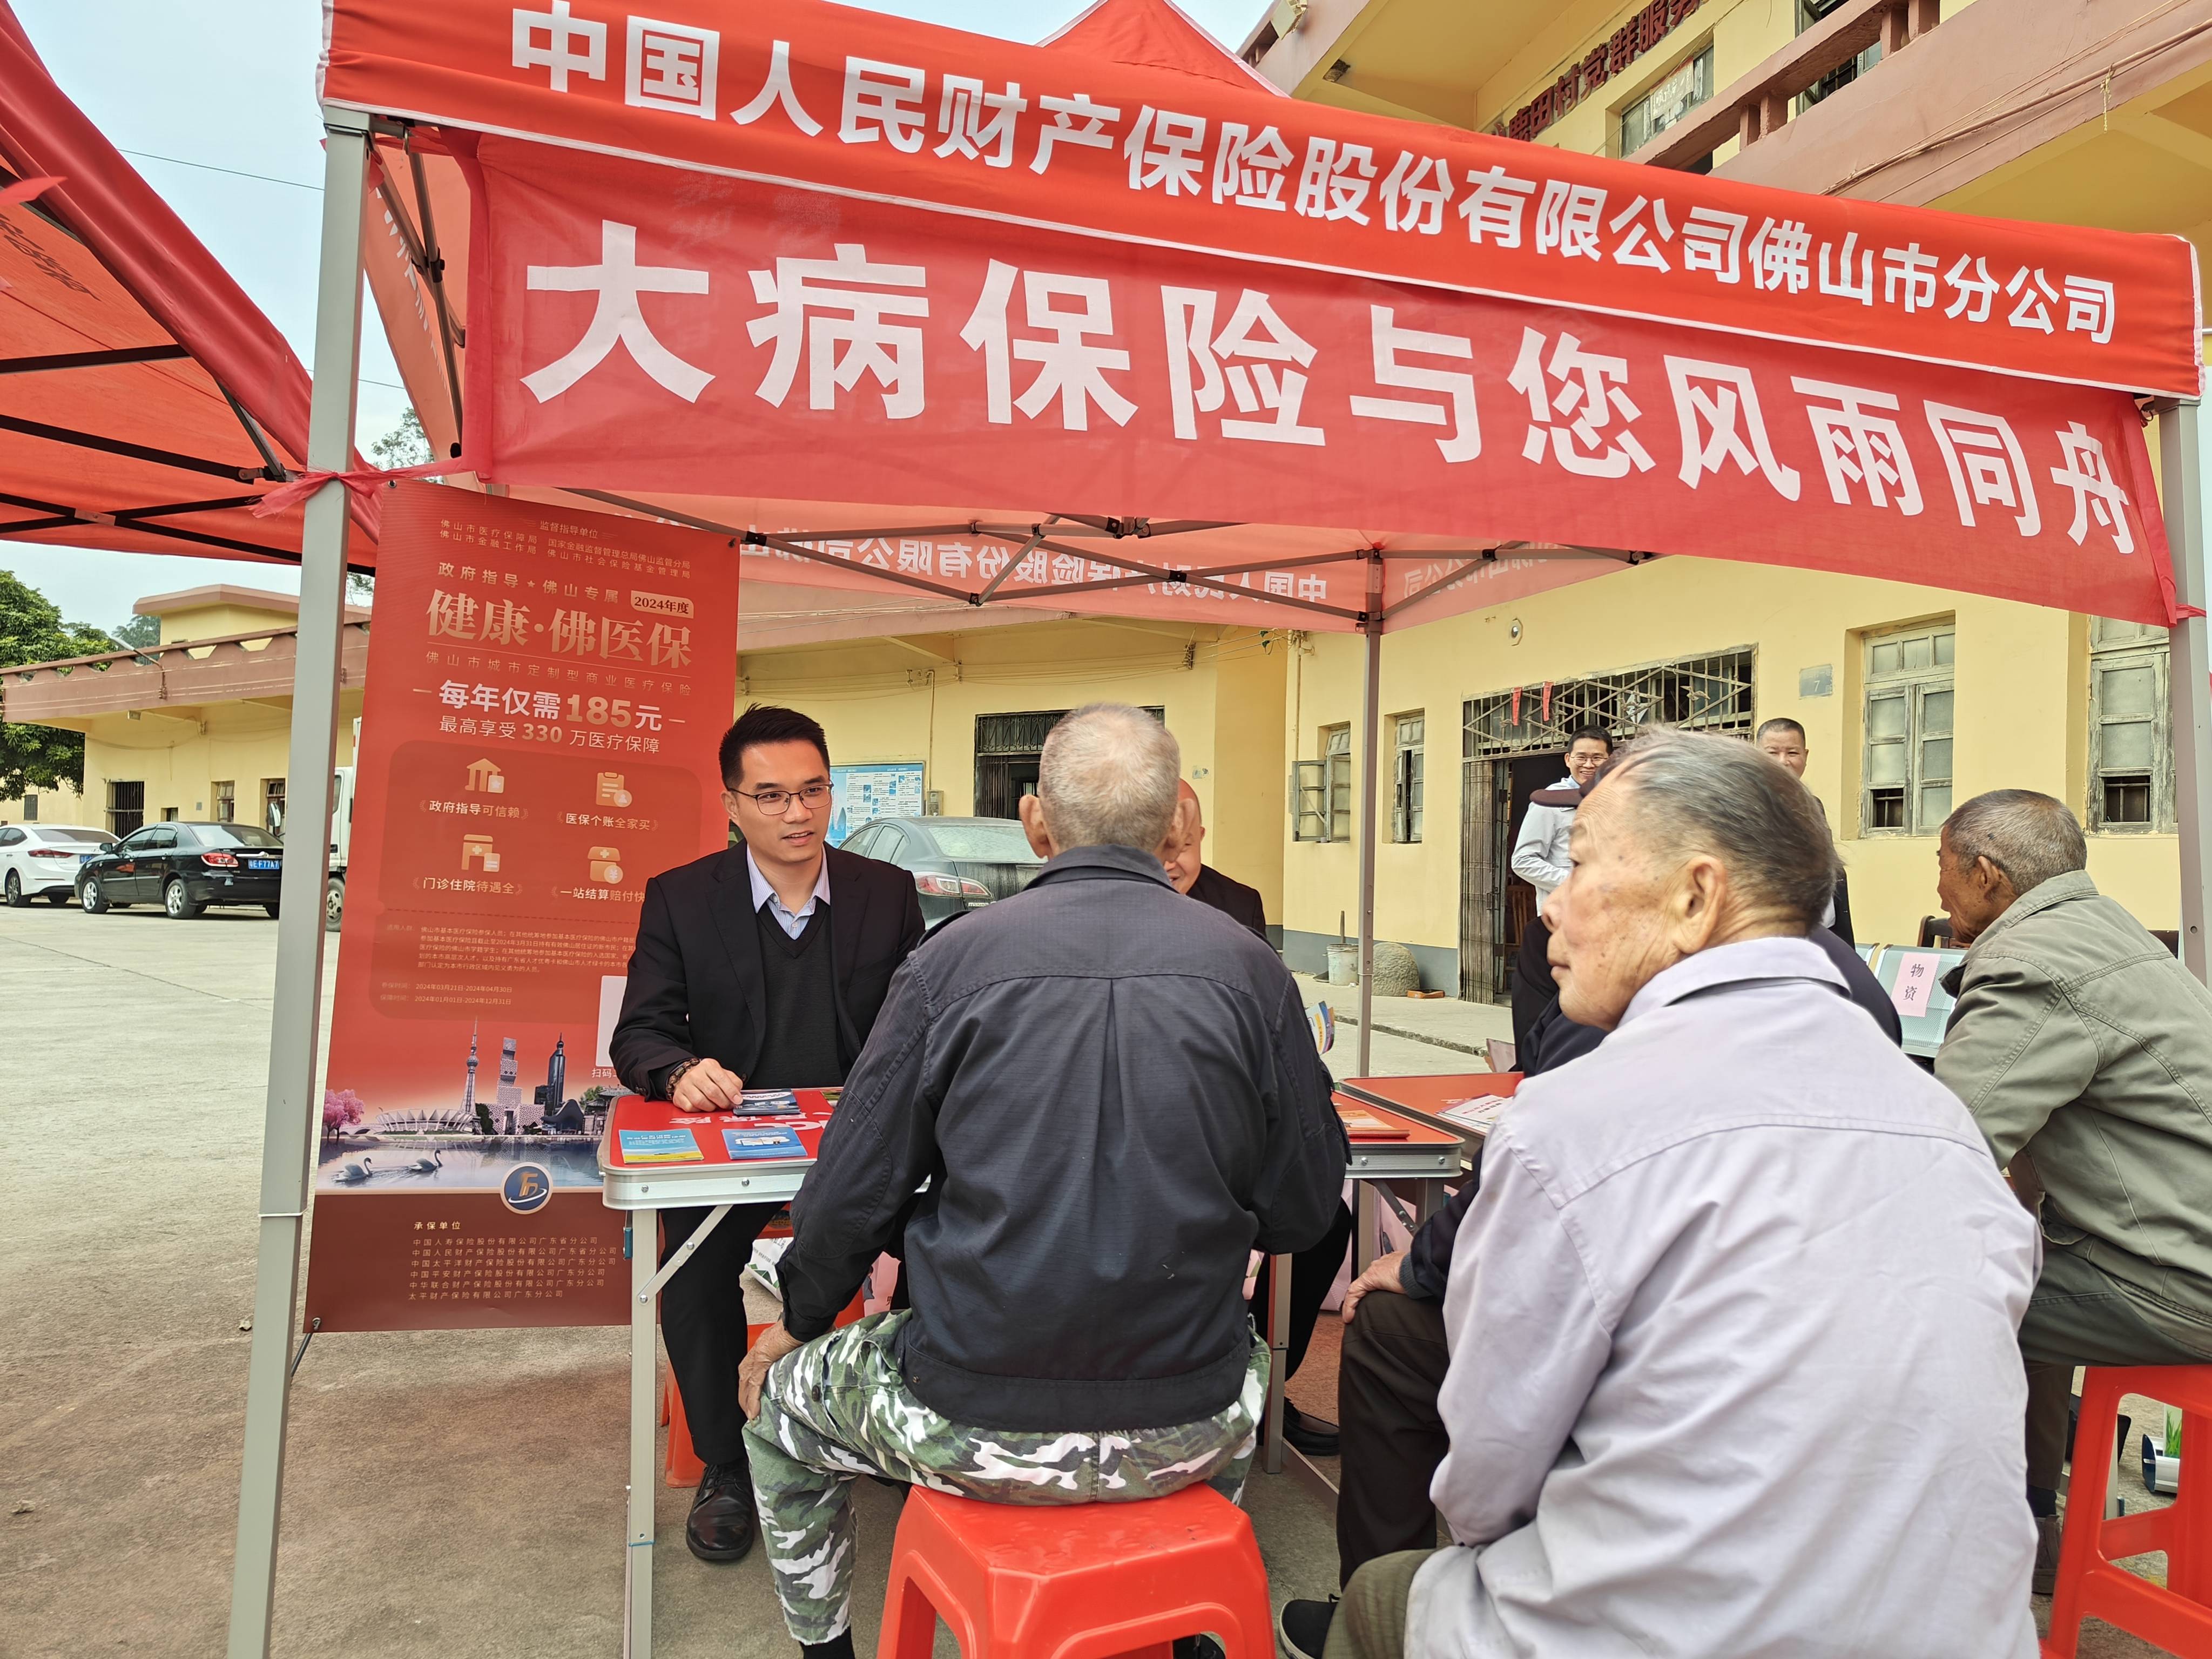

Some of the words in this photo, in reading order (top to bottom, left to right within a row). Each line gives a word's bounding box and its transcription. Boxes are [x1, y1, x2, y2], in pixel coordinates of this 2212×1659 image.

[512, 0, 2114, 343] 中国人民财产保险股份有限公司佛山市分公司
[520, 220, 2134, 554] 大病保险与您风雨同舟
[441, 519, 537, 544] 佛山市医疗保障局
[540, 521, 598, 539] 监督指导单位
[440, 529, 537, 555] 佛山市金融工作局
[548, 538, 690, 570] 国家金融监督管理总局佛山监管分局
[548, 549, 690, 579] 佛山市社会保险基金管理局
[634, 595, 690, 615] 2024年度
[426, 651, 691, 696] 佛山市城市定制型商业医疗保险
[439, 679, 662, 732] 每年仅需185元
[429, 800, 520, 819] 政府指导可信赖
[565, 813, 650, 831] 医保个账全家买
[423, 877, 514, 894] 门诊住院待遇全
[560, 887, 645, 902] 一站结算赔付快
[1903, 963, 1924, 1001] 物资
[414, 1221, 461, 1230] 承保单位
[413, 1237, 597, 1247] 中国人寿保险股份有限公司广东省分公司
[412, 1247, 617, 1257] 中国人民财产保险股份有限公司广东省分公司
[412, 1257, 616, 1268] 中国太平洋财产保险股份有限公司广东分公司
[410, 1268, 605, 1279] 中国平安财产保险股份有限公司广东分公司
[409, 1279, 604, 1290] 中华联合财产保险股份有限公司广东分公司
[408, 1290, 563, 1300] 太平财产保险有限公司广东分公司
